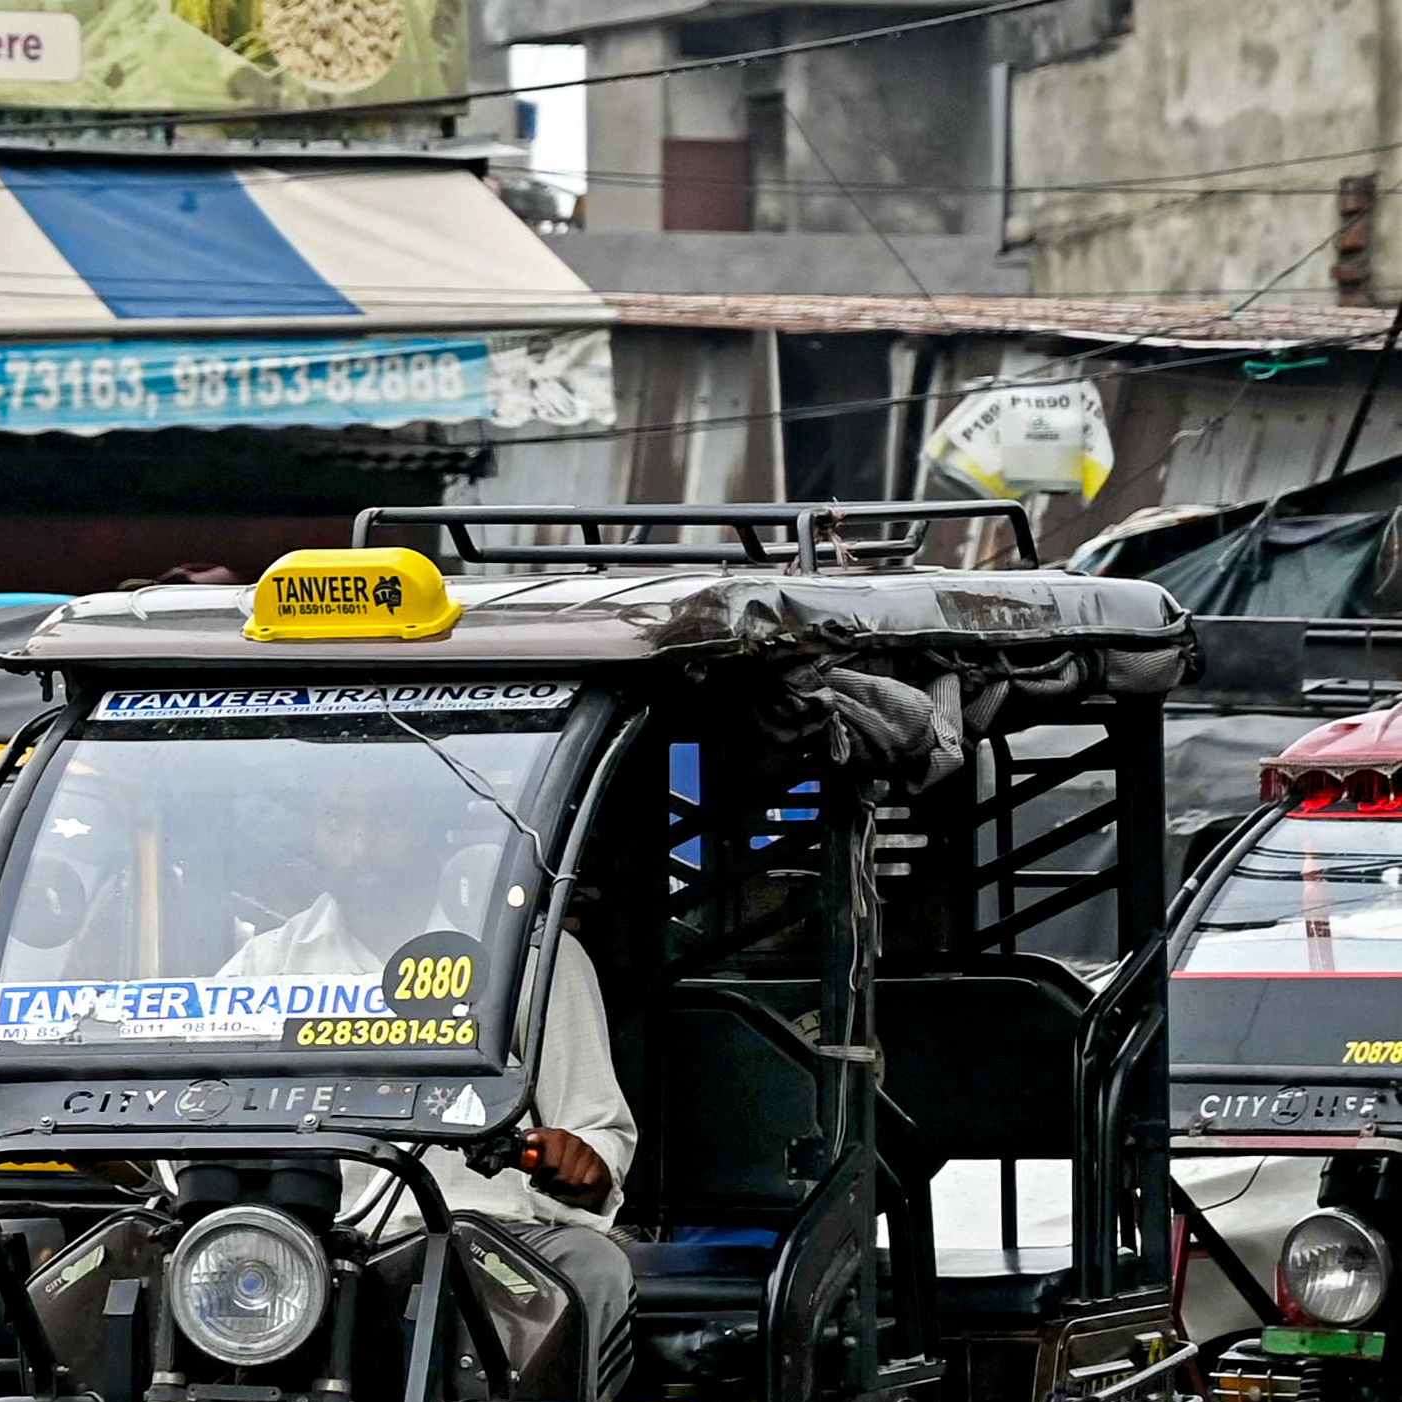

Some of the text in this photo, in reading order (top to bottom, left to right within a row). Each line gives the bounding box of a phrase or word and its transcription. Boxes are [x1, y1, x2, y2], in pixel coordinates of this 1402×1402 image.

[272, 575, 370, 603] TANVEER
[277, 603, 368, 618] (M) 85910-16011
[117, 690, 299, 709] TANVEER
[312, 684, 498, 705] TRADING
[395, 953, 472, 1001] 2880
[4, 983, 387, 1024] TANEER TRADING
[296, 1019, 475, 1047] 6283081456
[63, 1089, 169, 1115] CITY
[242, 1086, 335, 1112] LIFE
[1199, 1094, 1268, 1119] CITY
